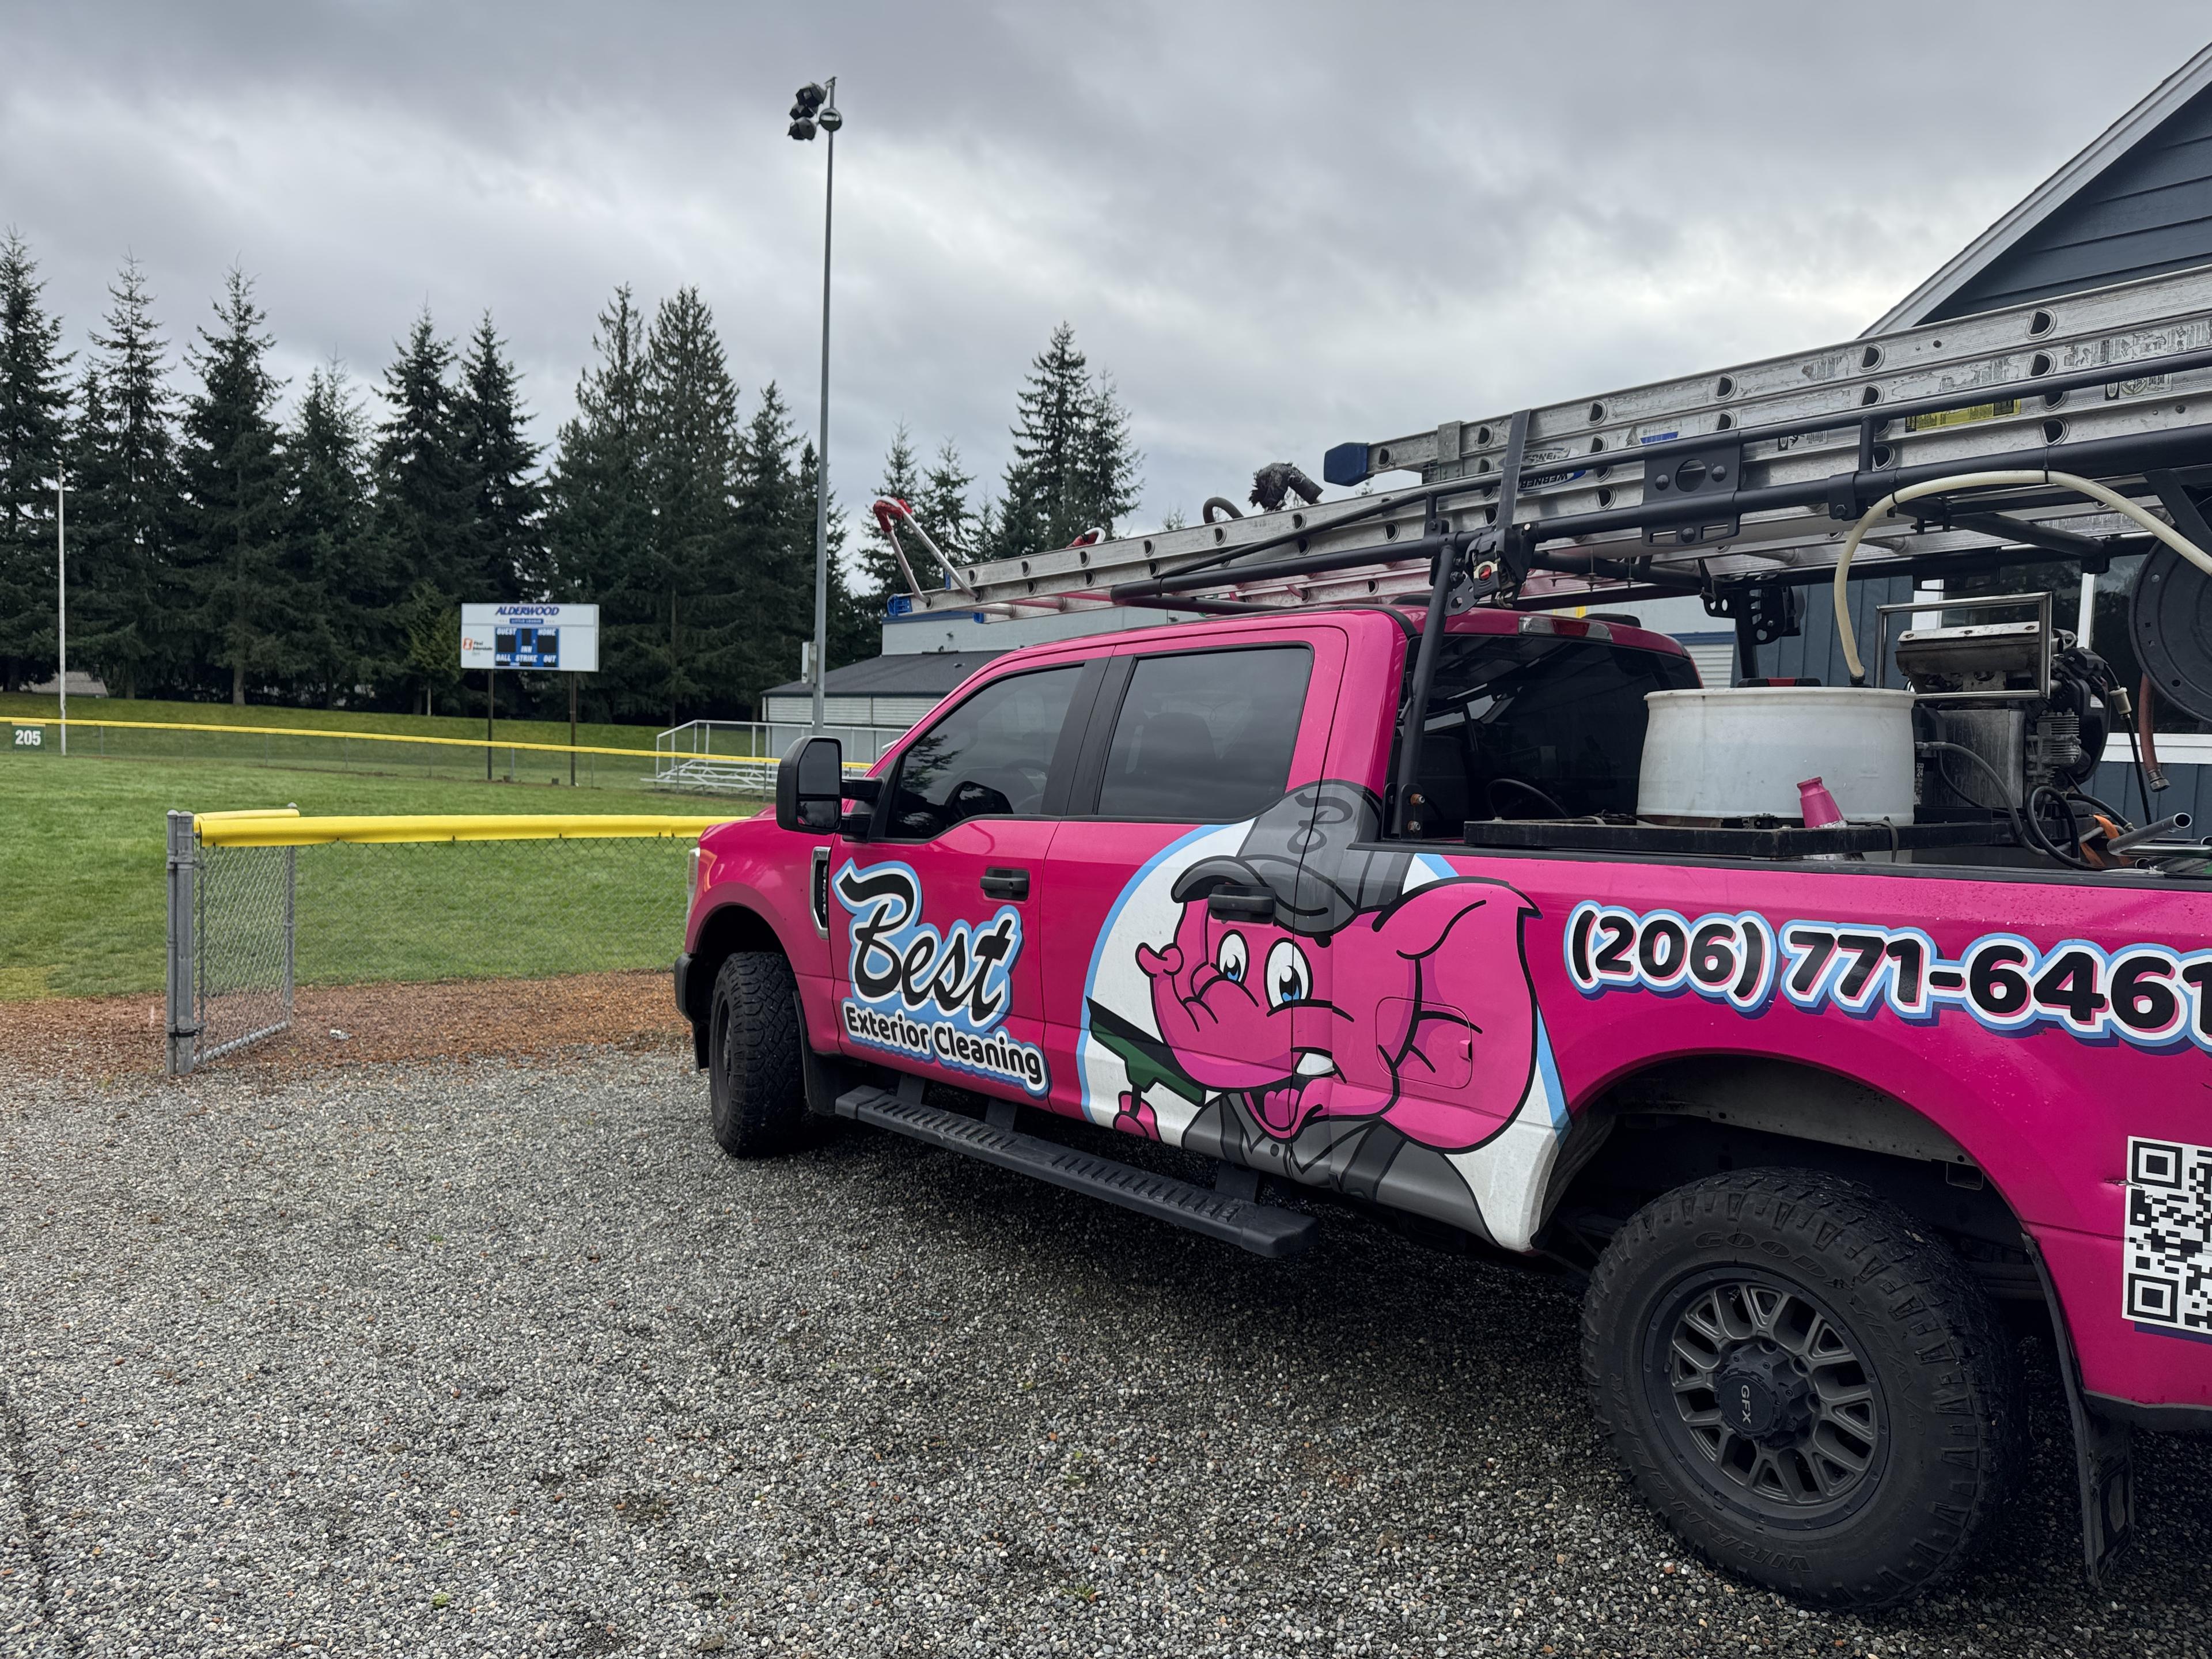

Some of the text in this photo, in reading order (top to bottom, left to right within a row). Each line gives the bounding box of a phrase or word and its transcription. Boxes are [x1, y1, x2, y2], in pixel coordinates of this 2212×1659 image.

[1520, 473, 1568, 488] WERNER
[495, 606, 559, 616] ALDERWOOD
[496, 627, 517, 635] GUEST
[537, 628, 556, 636] HOME
[521, 645, 533, 653] INN
[495, 654, 511, 662] BALL
[515, 654, 537, 662] STRIKE
[543, 654, 556, 663] OUT
[15, 729, 41, 746] 205
[838, 870, 1014, 1024] Best
[1572, 908, 2212, 1040] (206) 771-6461
[844, 1006, 1043, 1086] Exterior Cleaning
[1741, 1384, 1752, 1425] GFX
[1609, 1372, 1812, 1573] WRANGLER
